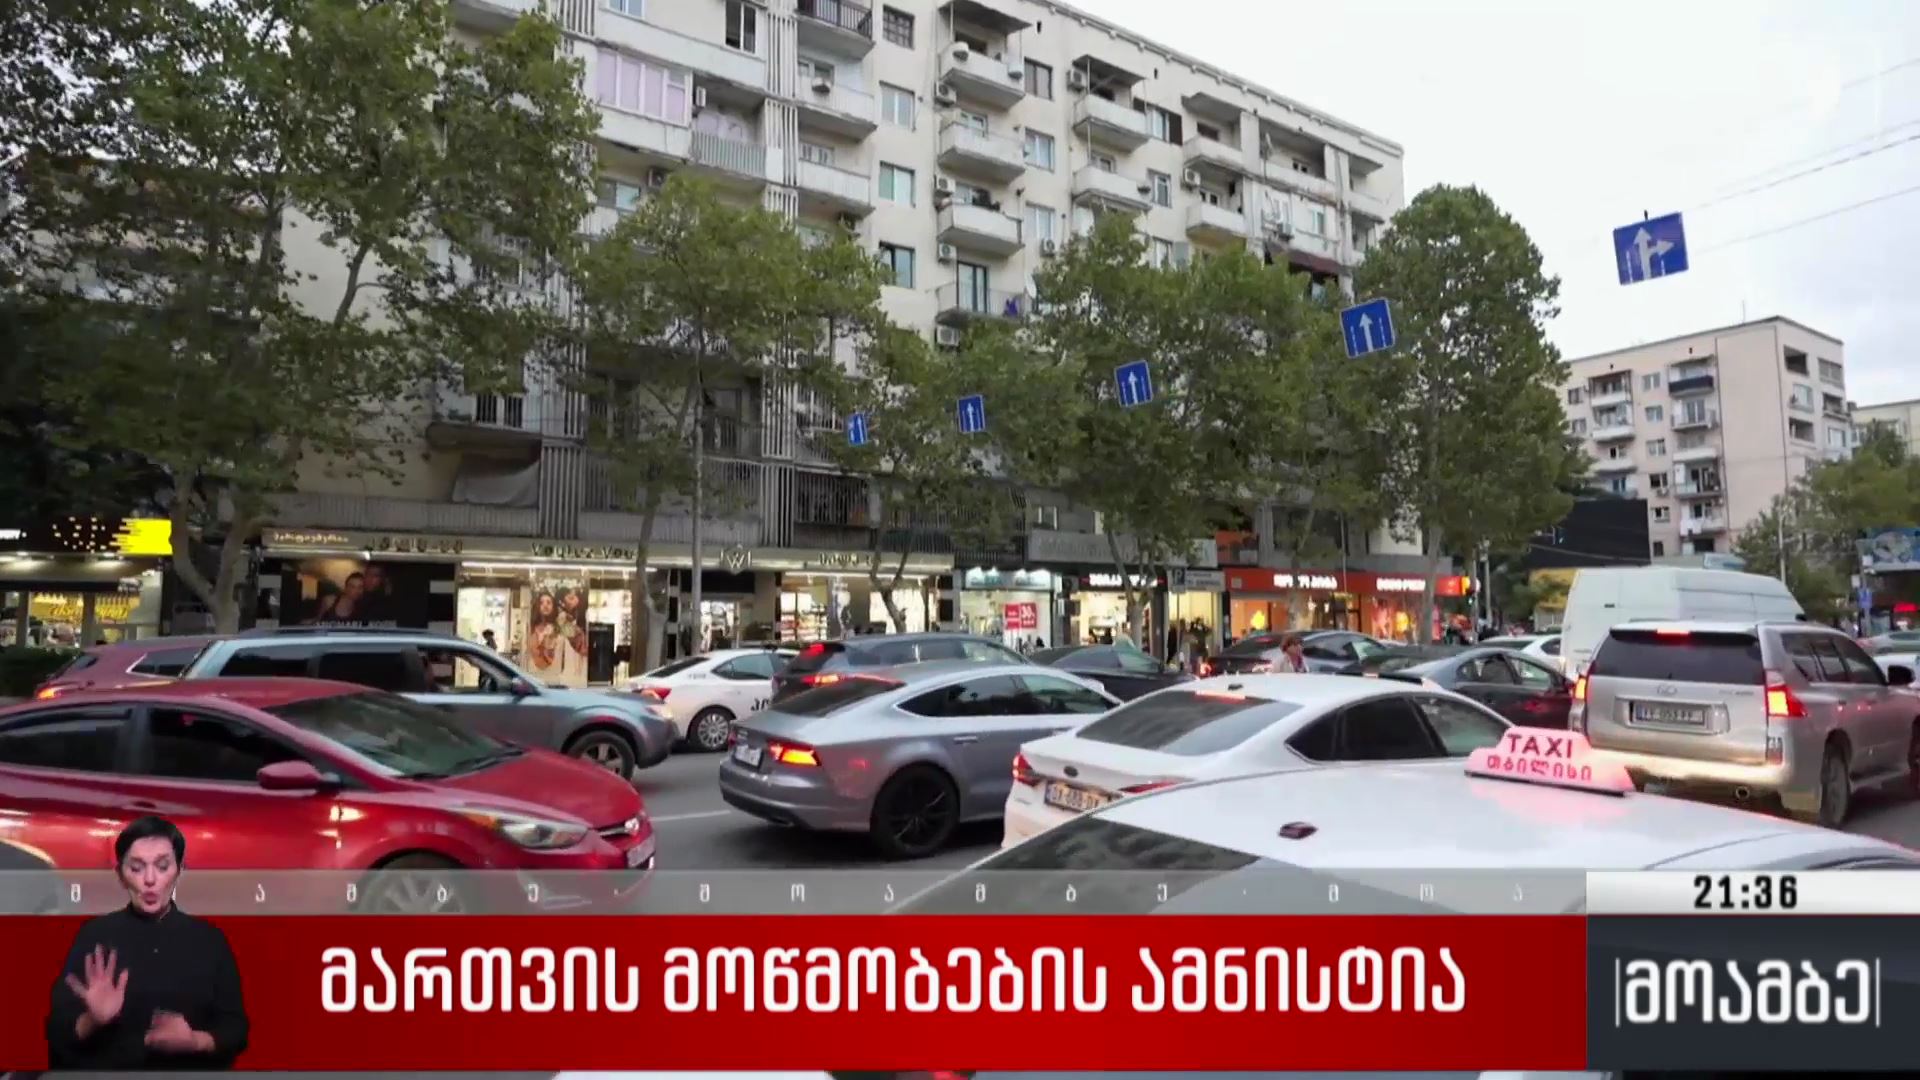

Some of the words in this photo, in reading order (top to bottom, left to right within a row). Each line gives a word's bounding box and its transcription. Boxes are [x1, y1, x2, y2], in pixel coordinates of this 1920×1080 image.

[602, 545, 635, 561] Vou
[1507, 732, 1573, 759] TAXI
[1487, 754, 1592, 782] თბილისი
